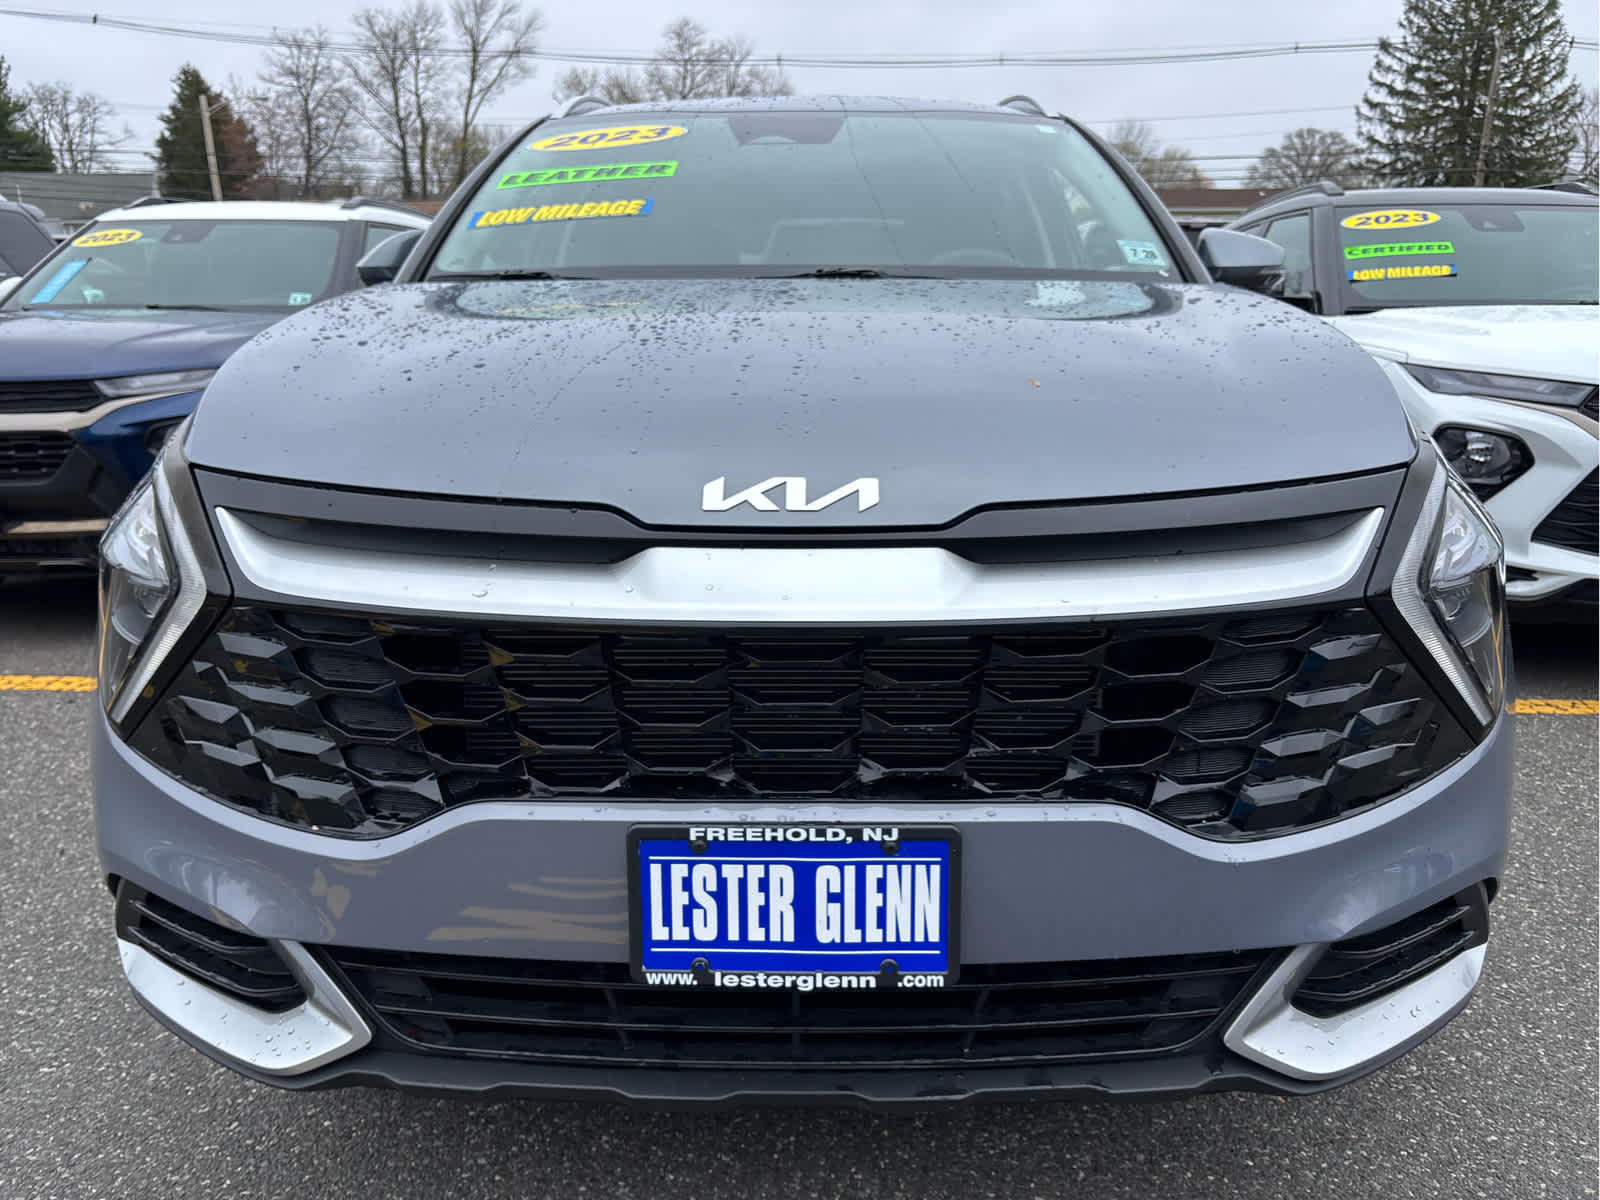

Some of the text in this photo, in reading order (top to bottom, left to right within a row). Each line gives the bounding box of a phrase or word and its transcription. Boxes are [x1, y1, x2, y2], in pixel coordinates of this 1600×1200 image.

[544, 127, 670, 148] 2023
[503, 164, 669, 186] LEATHER
[476, 199, 647, 227] LOW MILEAGE
[1355, 213, 1430, 227] 2023
[1347, 244, 1450, 256] CERTIFIED
[1353, 265, 1451, 280] LOW MILEAGE
[689, 827, 899, 844] FREEHOLD, NJ
[650, 863, 941, 944] LESTER GLENN
[646, 972, 945, 991] www. lesterglenn .com
